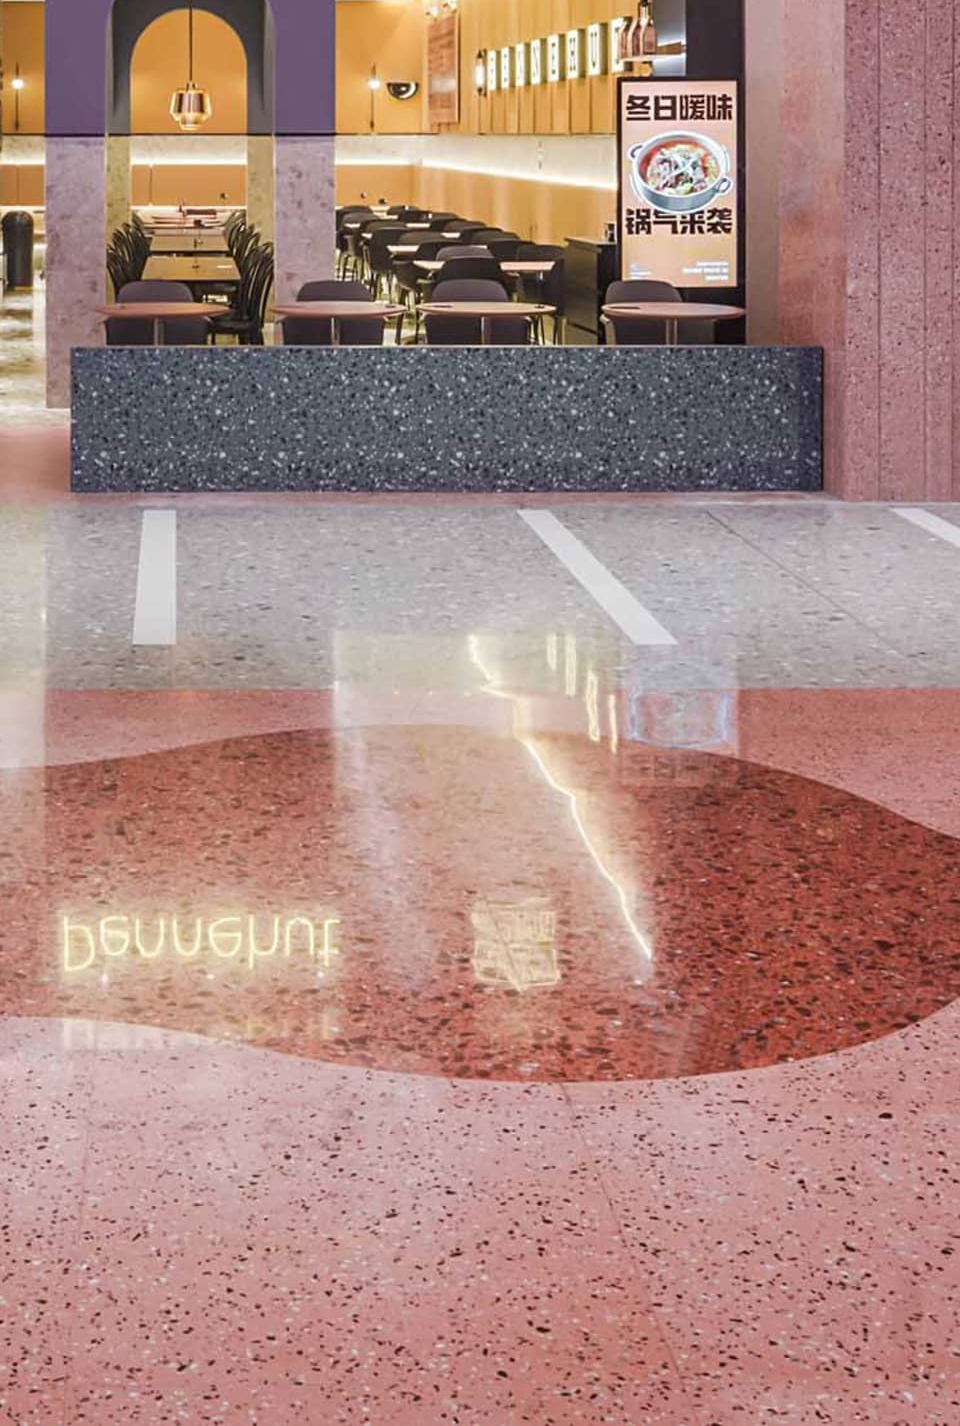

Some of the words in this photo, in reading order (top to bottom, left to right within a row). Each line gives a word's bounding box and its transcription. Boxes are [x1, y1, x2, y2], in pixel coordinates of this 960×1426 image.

[626, 93, 734, 121] 冬日暖味
[626, 207, 733, 235] 锅气来袭
